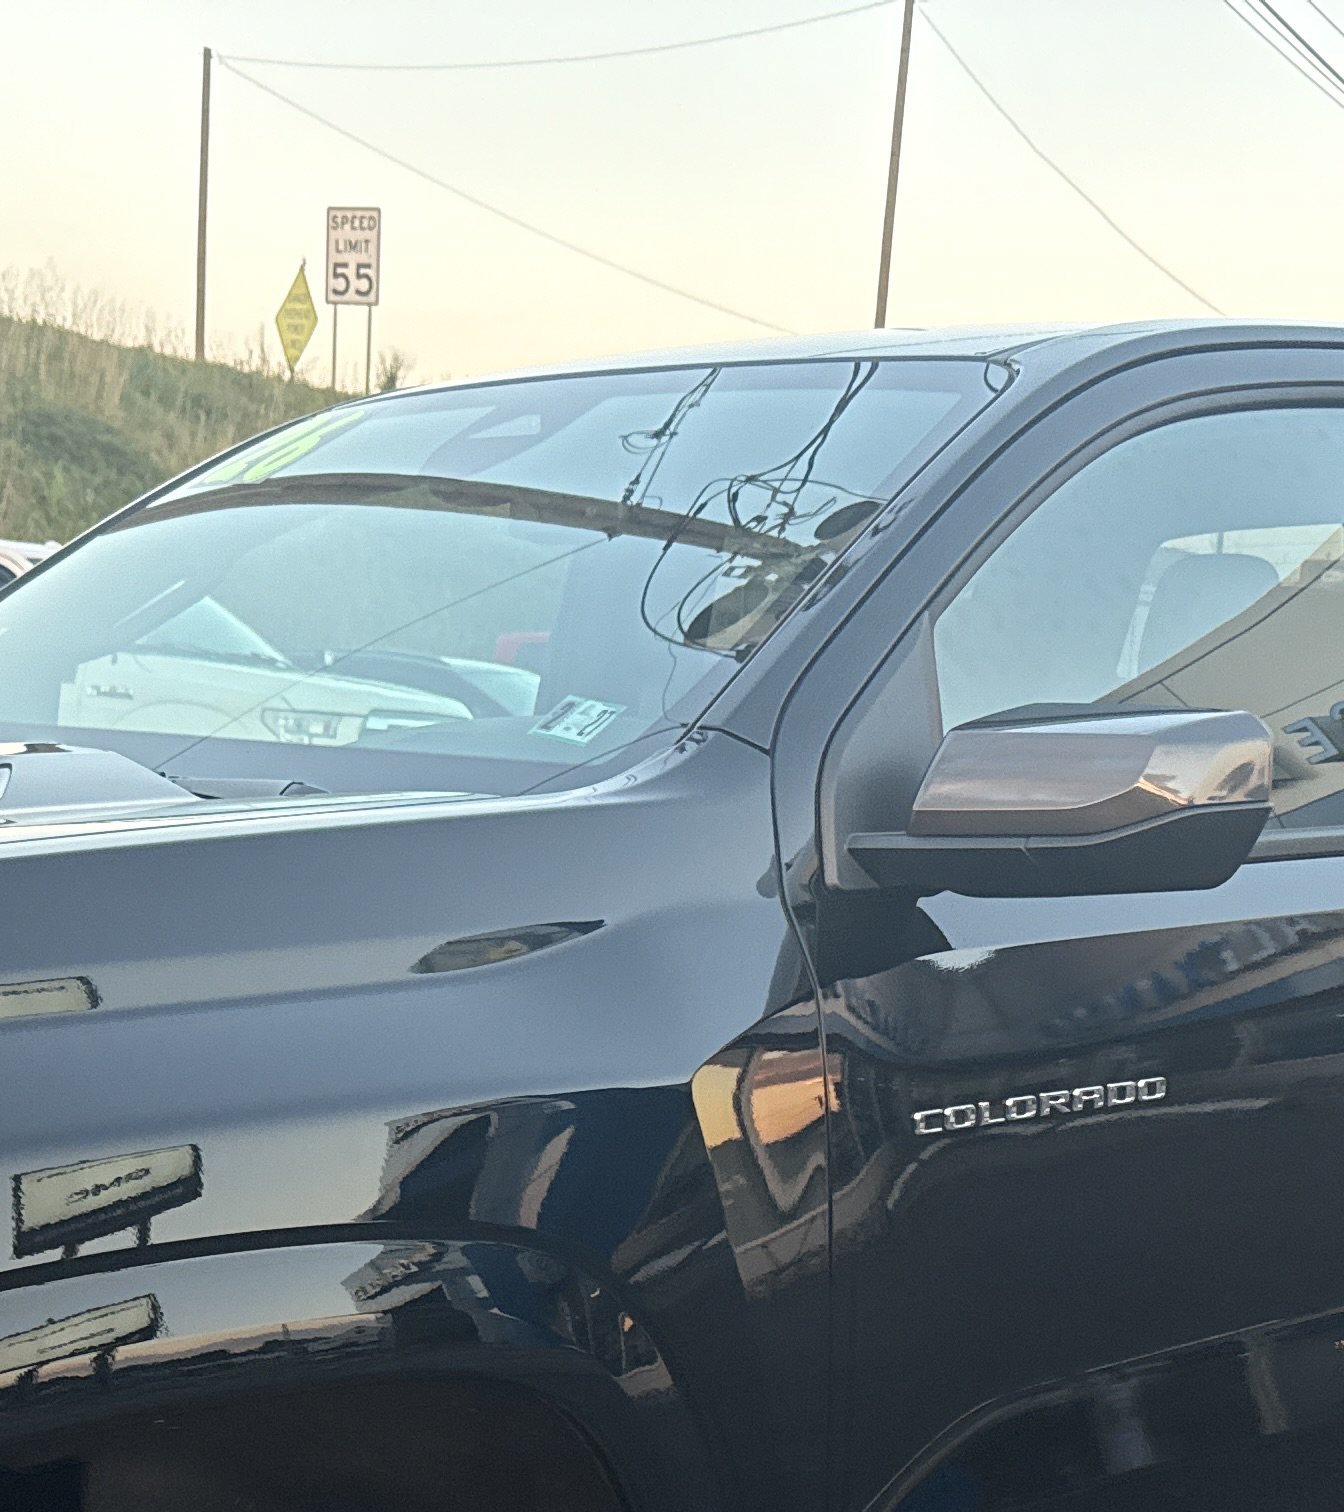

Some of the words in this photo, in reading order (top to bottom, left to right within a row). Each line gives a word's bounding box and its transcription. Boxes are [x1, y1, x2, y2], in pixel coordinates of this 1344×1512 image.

[331, 214, 377, 231] SPEED
[335, 239, 371, 254] LIMIT
[332, 262, 373, 296] 55
[913, 1076, 1167, 1135] COLORADO
